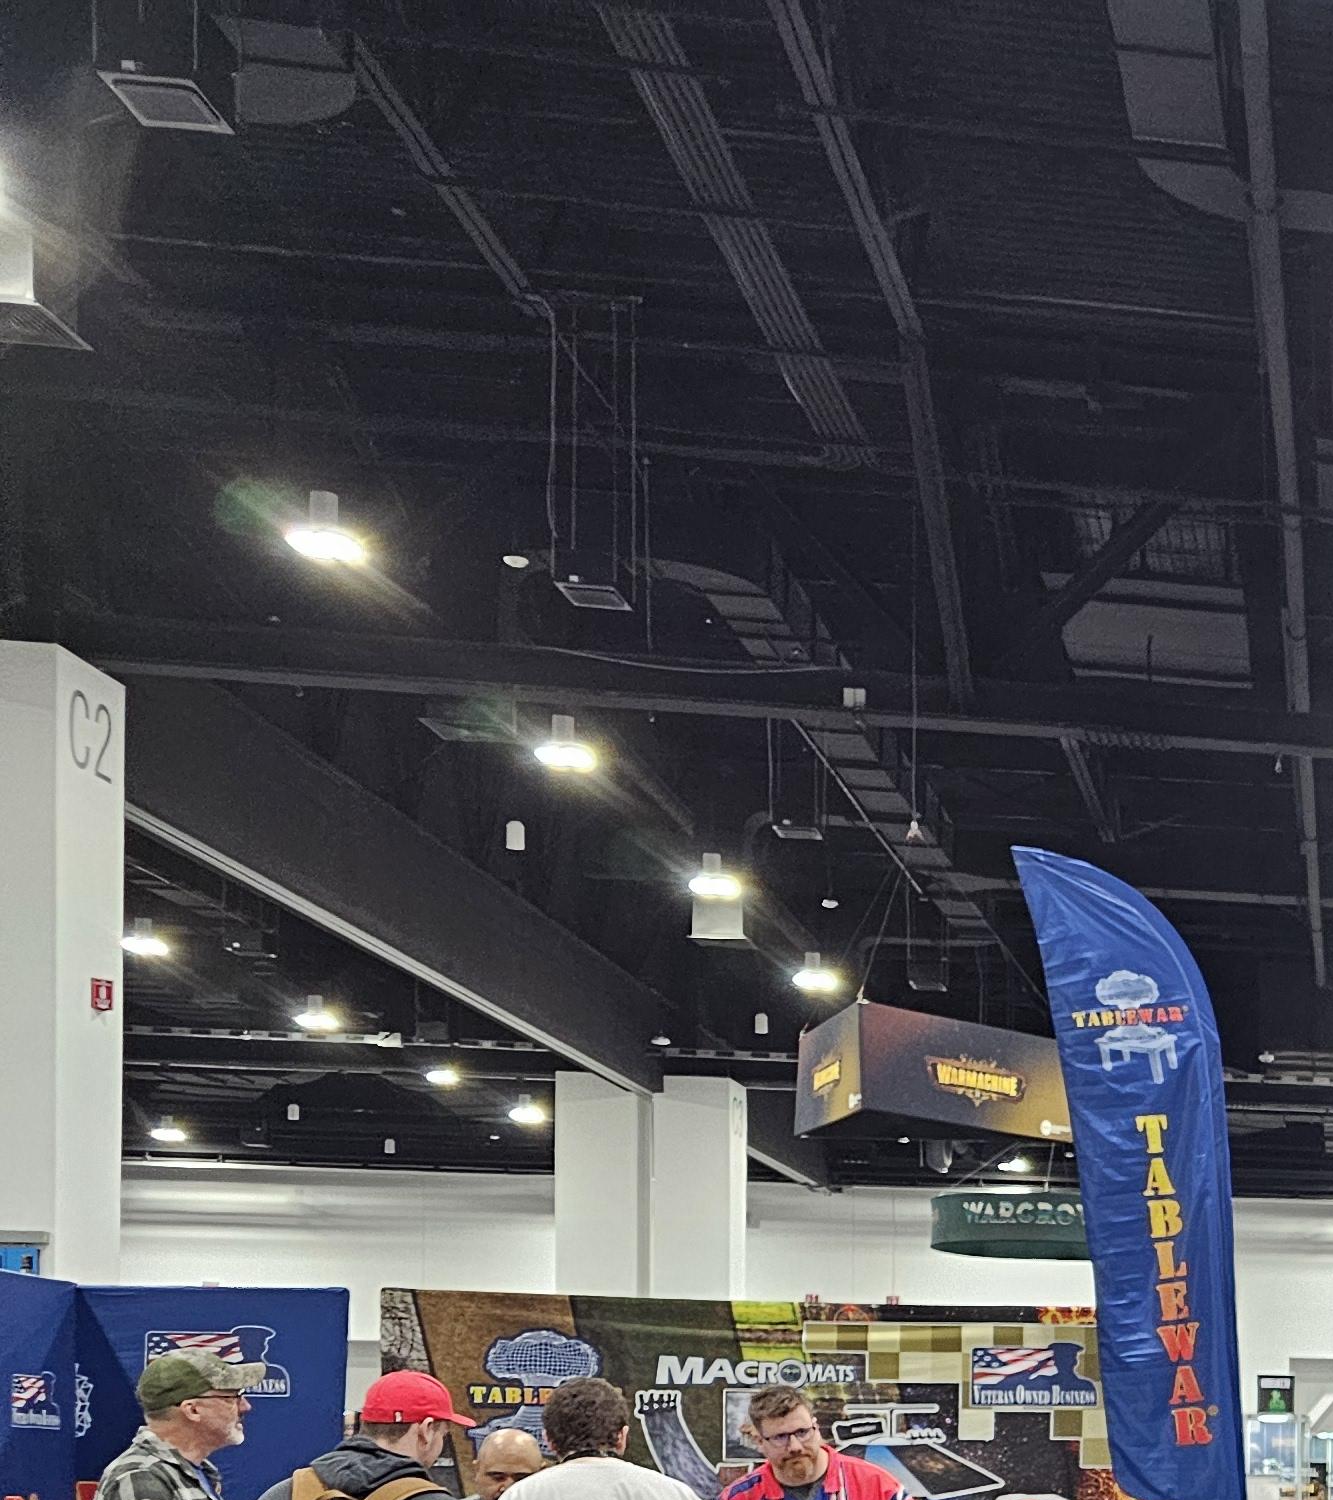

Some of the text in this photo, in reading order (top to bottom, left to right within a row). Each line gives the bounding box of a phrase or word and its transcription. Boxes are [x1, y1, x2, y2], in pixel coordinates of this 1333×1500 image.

[69, 688, 113, 785] C2
[1071, 1006, 1186, 1029] TABLEWAR
[655, 1354, 856, 1388] MACROMATS
